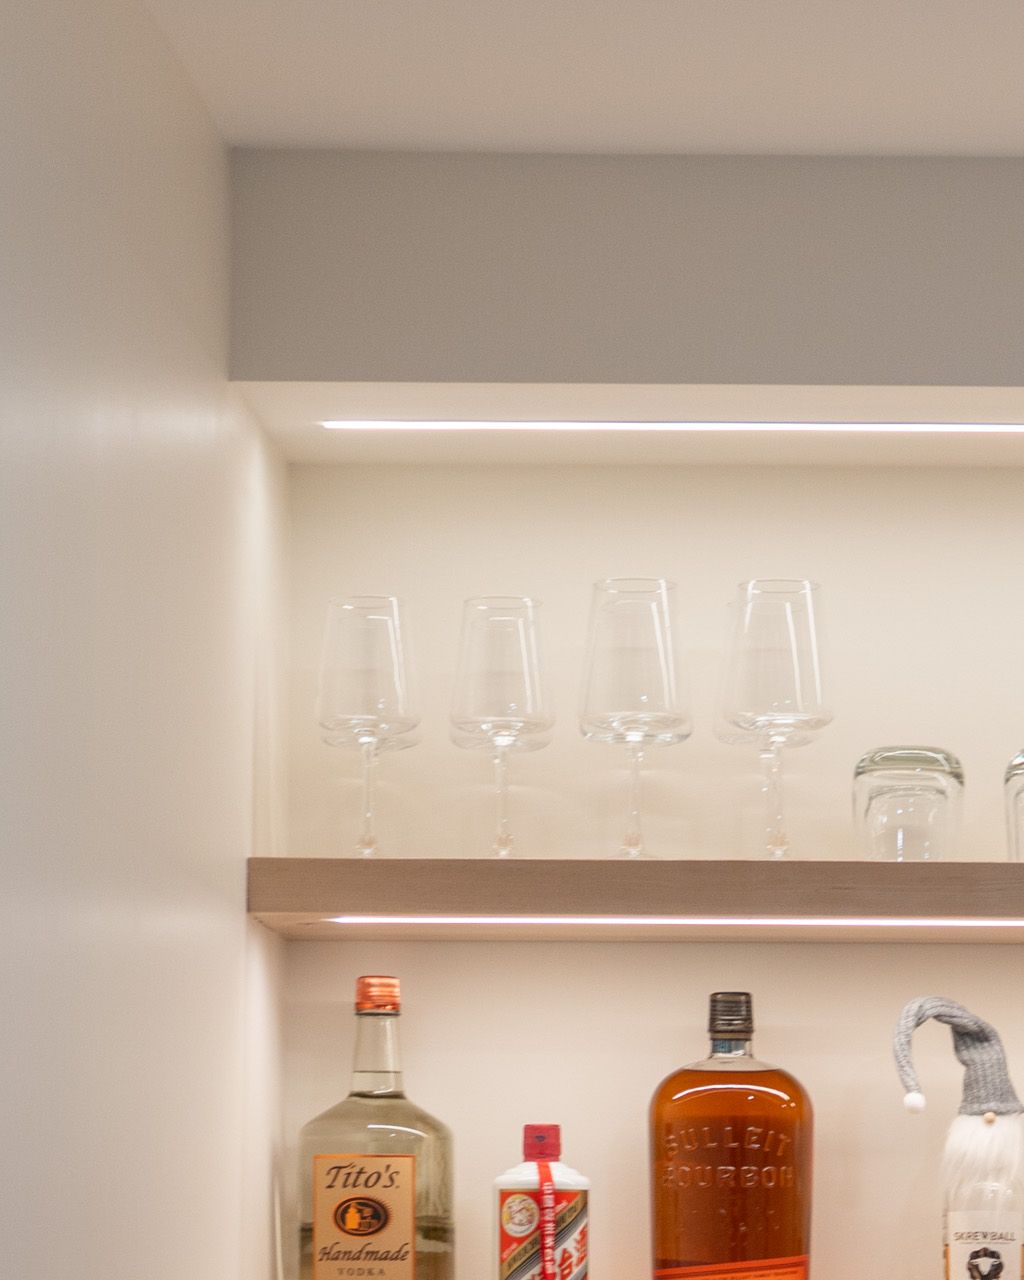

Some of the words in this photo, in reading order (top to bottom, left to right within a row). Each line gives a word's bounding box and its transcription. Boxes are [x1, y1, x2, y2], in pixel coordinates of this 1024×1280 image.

[665, 1126, 791, 1157] BULLEIT
[325, 1162, 400, 1189] Tito's
[953, 1231, 1016, 1241] SKREWBALL
[318, 1241, 410, 1262] Handmade
[336, 1267, 386, 1277] VODKA
